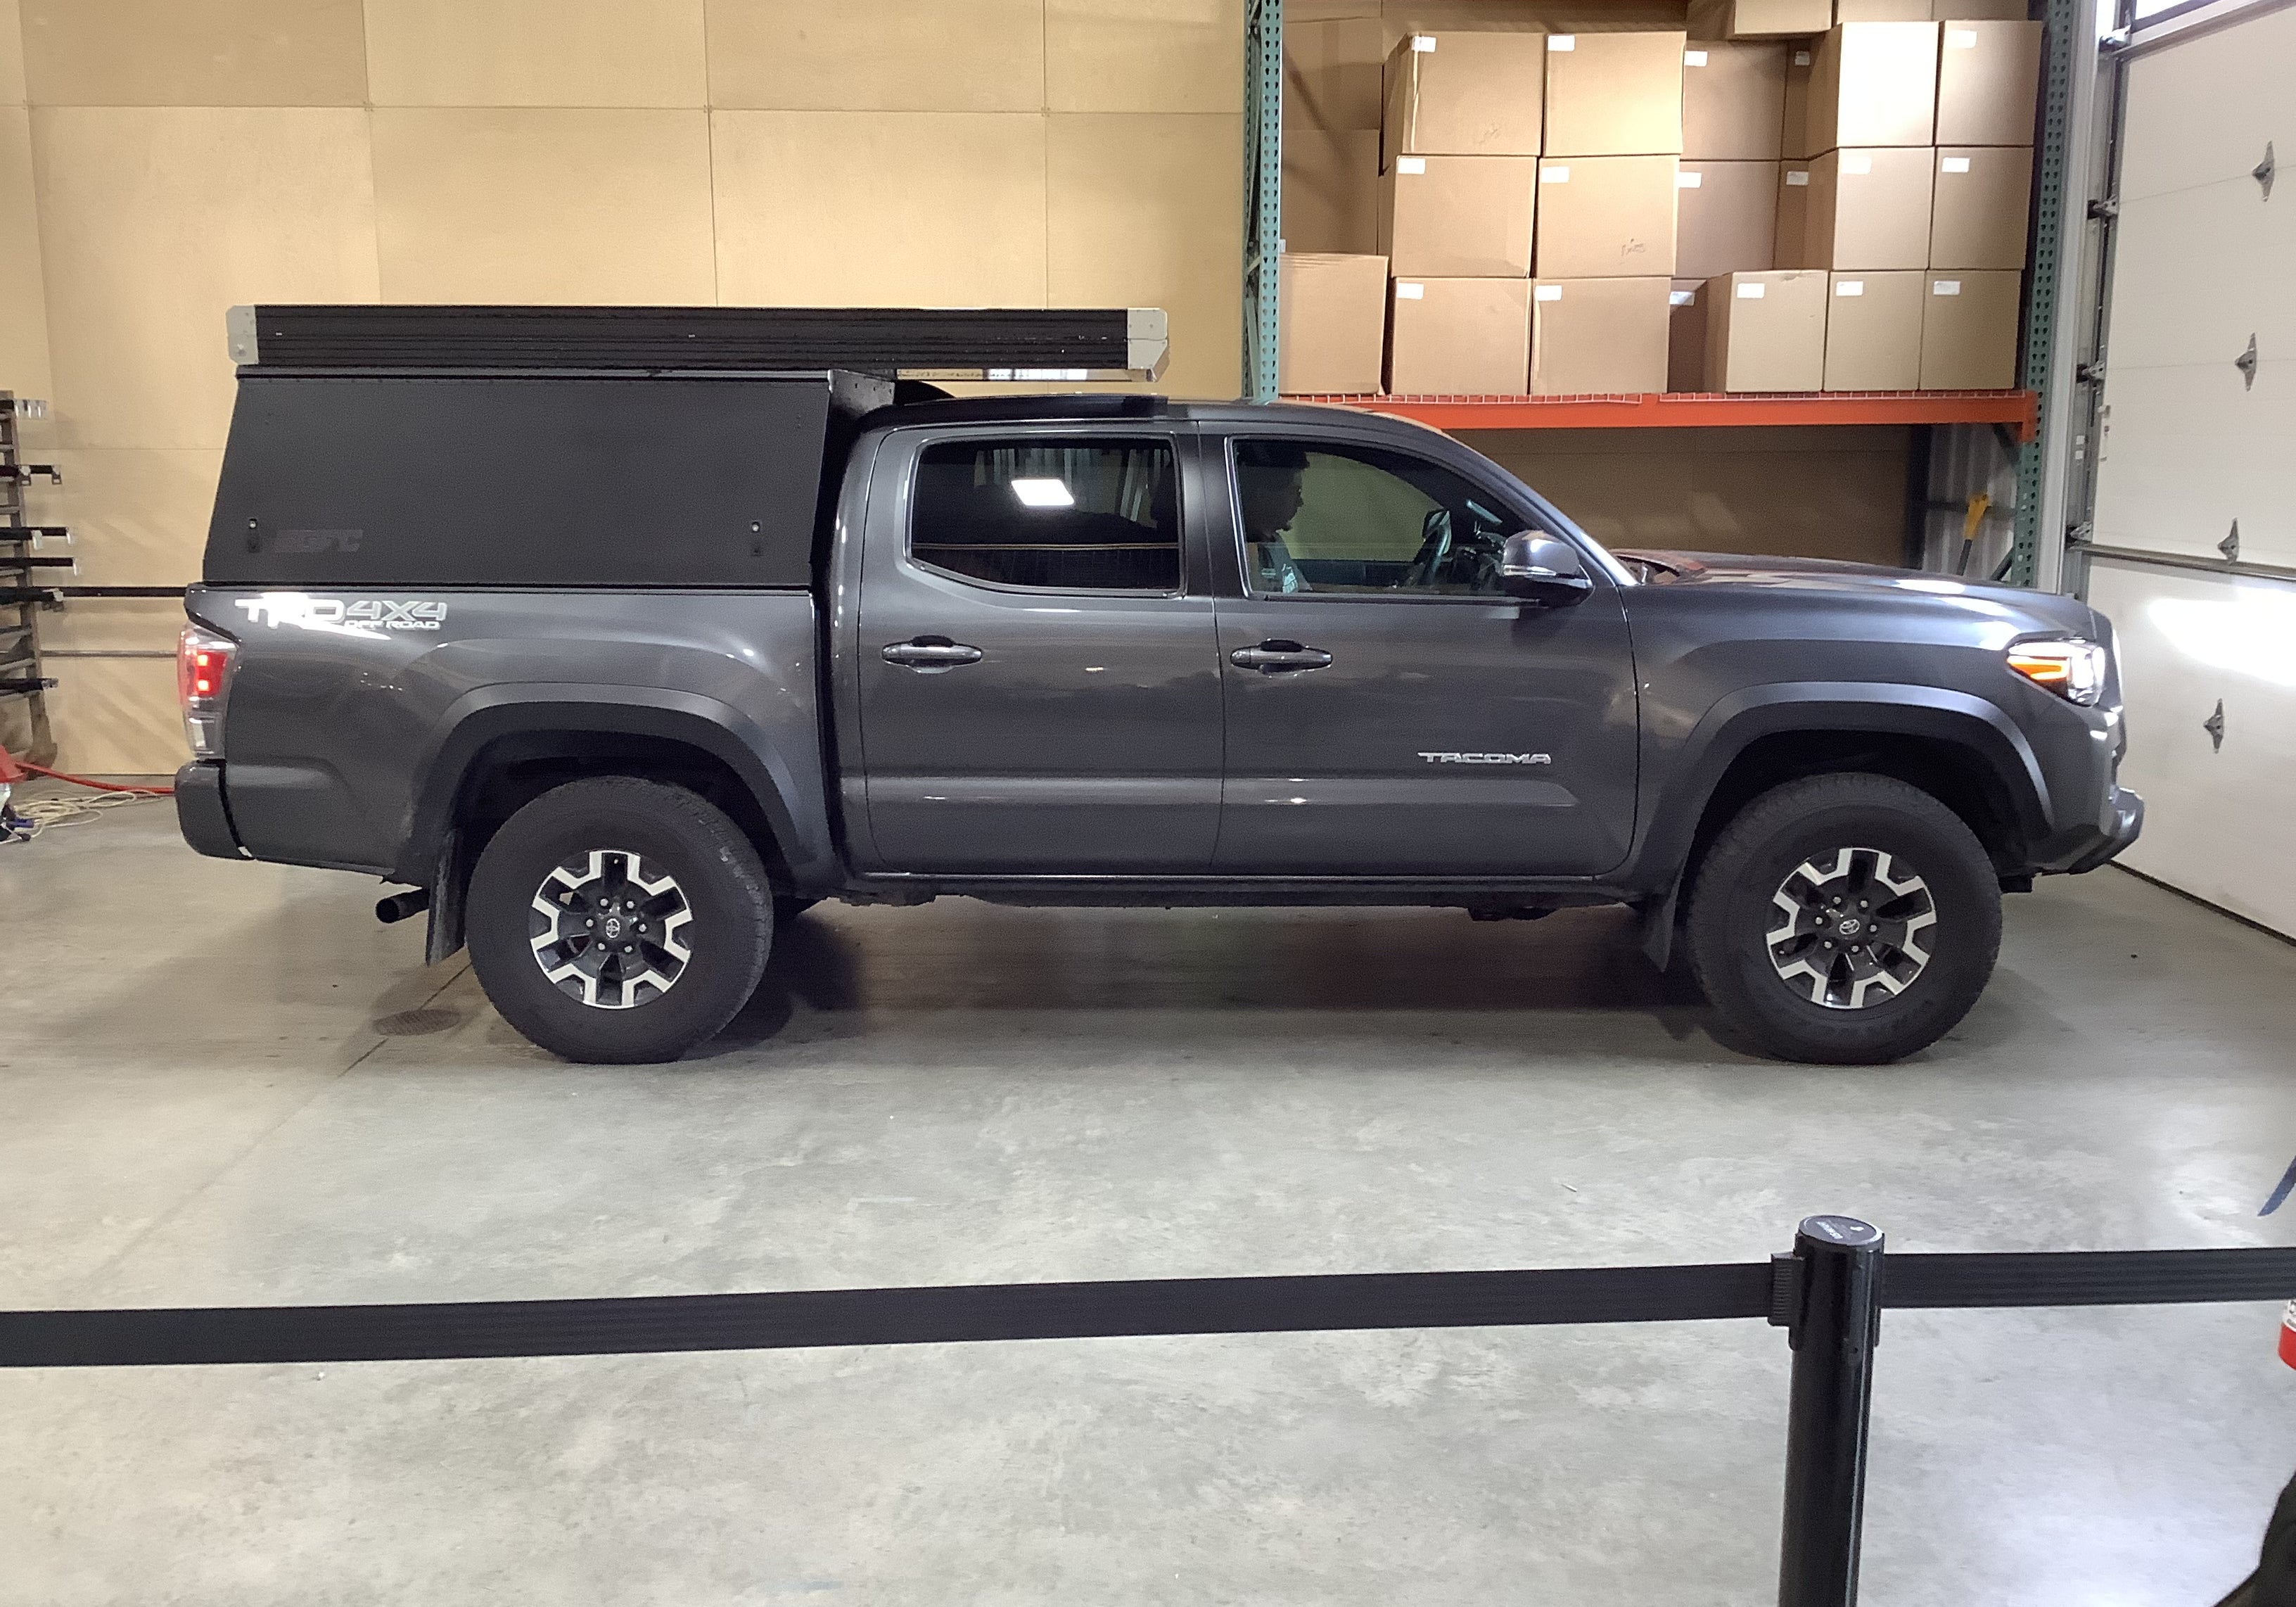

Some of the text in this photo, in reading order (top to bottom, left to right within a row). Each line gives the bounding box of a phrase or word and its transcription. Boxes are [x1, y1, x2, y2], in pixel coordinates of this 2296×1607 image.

[346, 600, 448, 621] 4X4
[385, 621, 440, 630] ROAD
[1417, 752, 1552, 764] TACOMA
